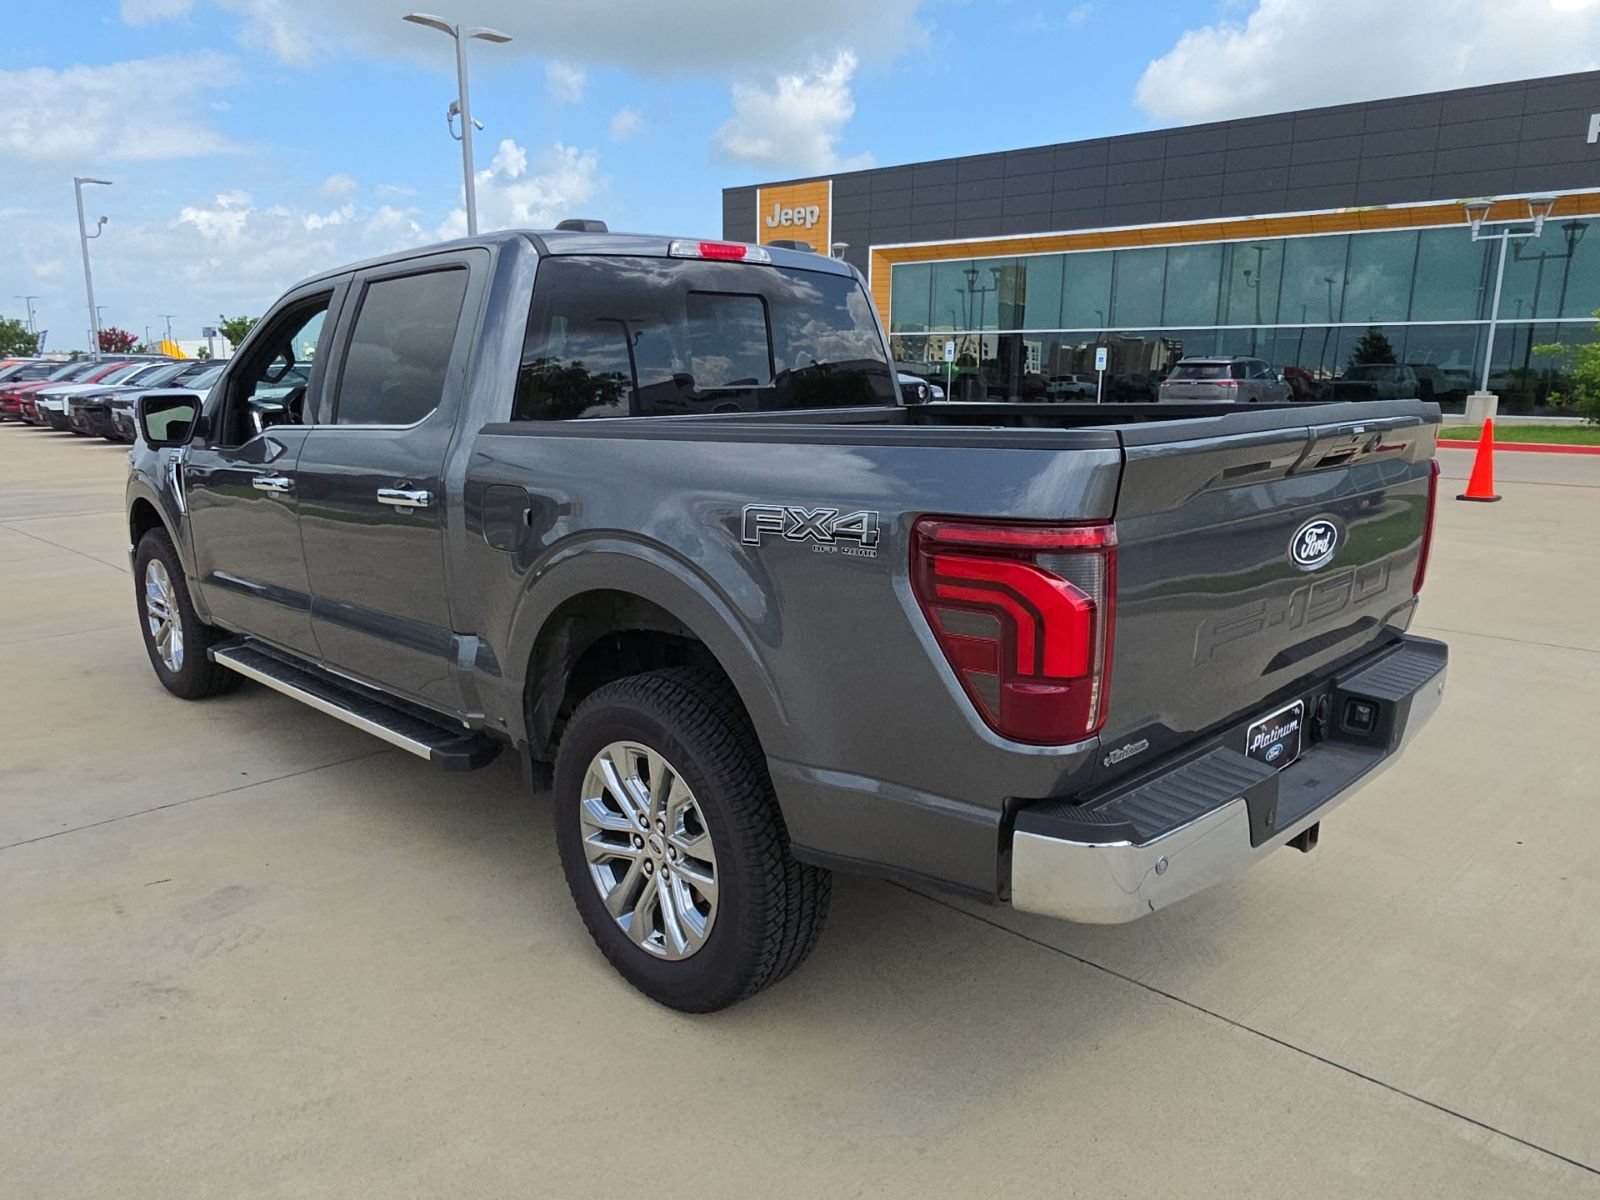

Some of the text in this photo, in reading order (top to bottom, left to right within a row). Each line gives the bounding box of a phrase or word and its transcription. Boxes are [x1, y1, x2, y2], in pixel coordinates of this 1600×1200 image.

[766, 203, 820, 229] Jeep
[741, 503, 880, 548] FX4
[1301, 527, 1331, 558] Ford
[1192, 560, 1393, 667] F-150
[1250, 719, 1299, 752] Platinum
